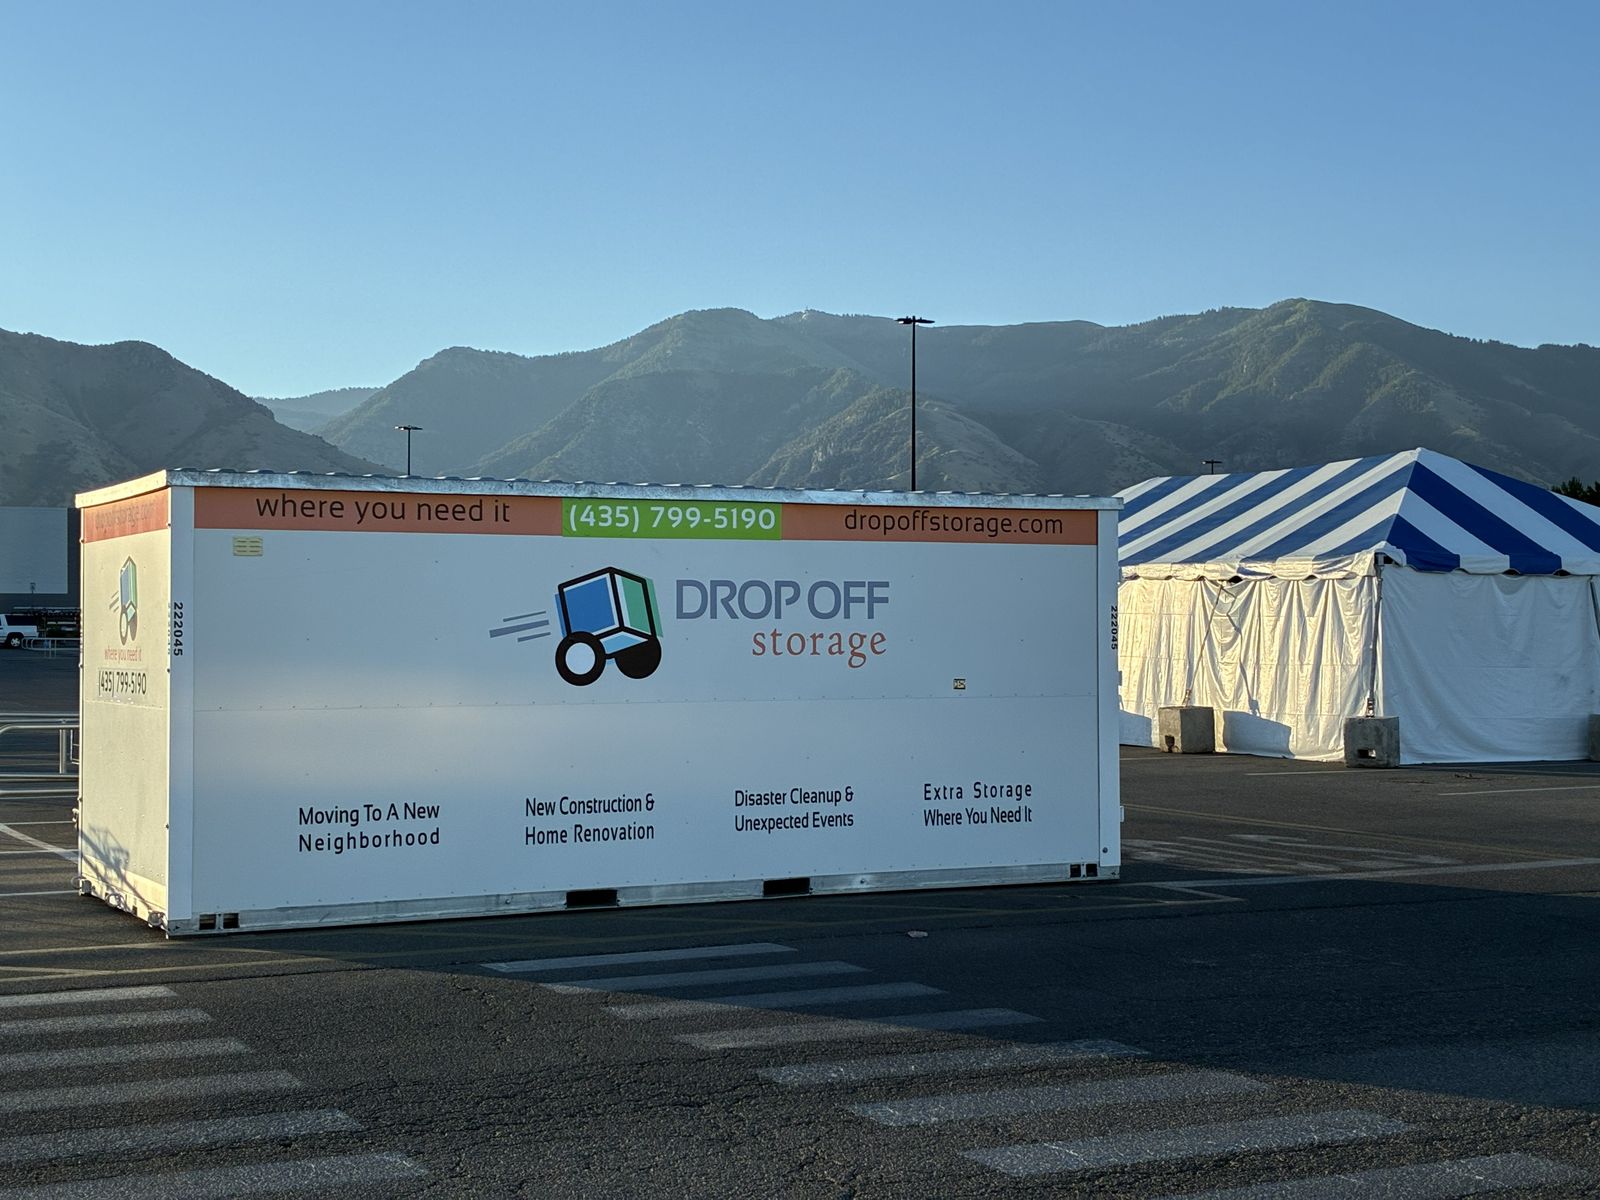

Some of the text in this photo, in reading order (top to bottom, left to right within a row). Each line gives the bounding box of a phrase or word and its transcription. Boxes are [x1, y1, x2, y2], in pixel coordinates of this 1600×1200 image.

[256, 493, 511, 525] where you need it
[569, 504, 776, 533] (435) 799-5190
[844, 509, 1063, 538] dropoffstorage.com
[676, 579, 890, 620] DROP OFF
[173, 601, 184, 657] 222045
[1110, 604, 1118, 650] 222045
[752, 628, 888, 669] storage
[99, 670, 147, 698] (435) 799-5190
[525, 792, 655, 817] New Construction &
[735, 785, 854, 807] Disaster Cleanup &
[924, 781, 1032, 802] Extra Storage
[299, 801, 441, 827] Moving To A New
[735, 811, 854, 835] Unexpected Events
[923, 804, 1033, 827] Where You Need It
[299, 826, 440, 855] Neighborhood
[525, 821, 655, 846] Home Renovation
